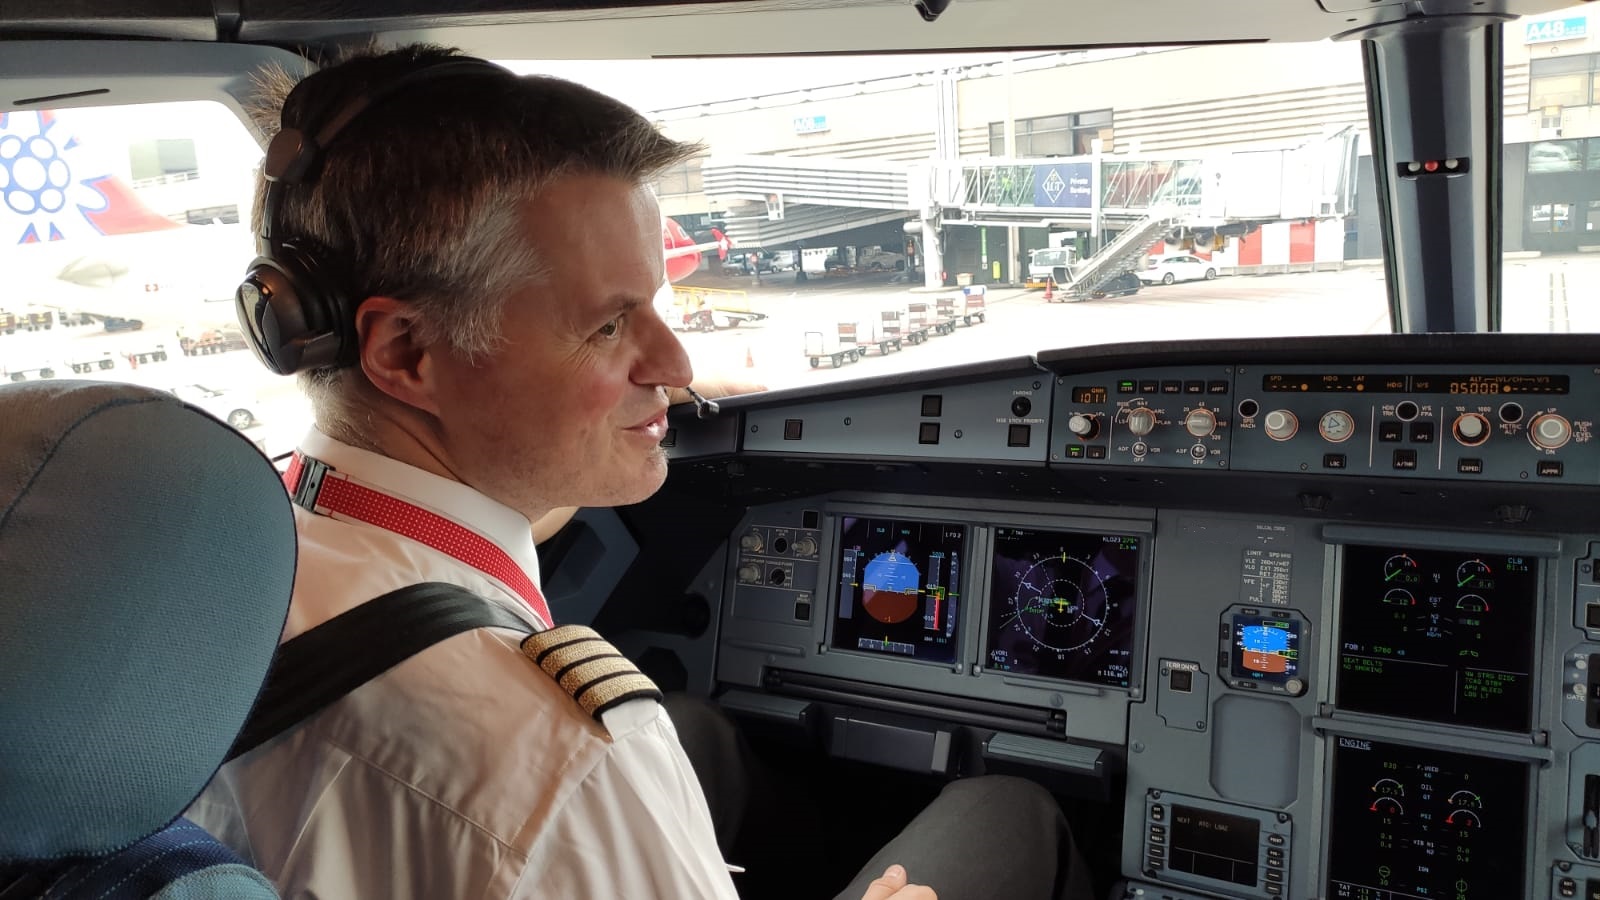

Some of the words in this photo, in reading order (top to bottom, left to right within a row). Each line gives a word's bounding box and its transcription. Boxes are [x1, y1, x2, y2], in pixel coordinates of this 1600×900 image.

[1527, 20, 1565, 40] A48
[1386, 381, 1403, 389] HDG
[1449, 382, 1499, 394] 05000
[1507, 557, 1523, 565] CLB
[1339, 737, 1371, 750] ENGINE
[1420, 783, 1433, 791] OIL
[1420, 812, 1432, 820] PSI
